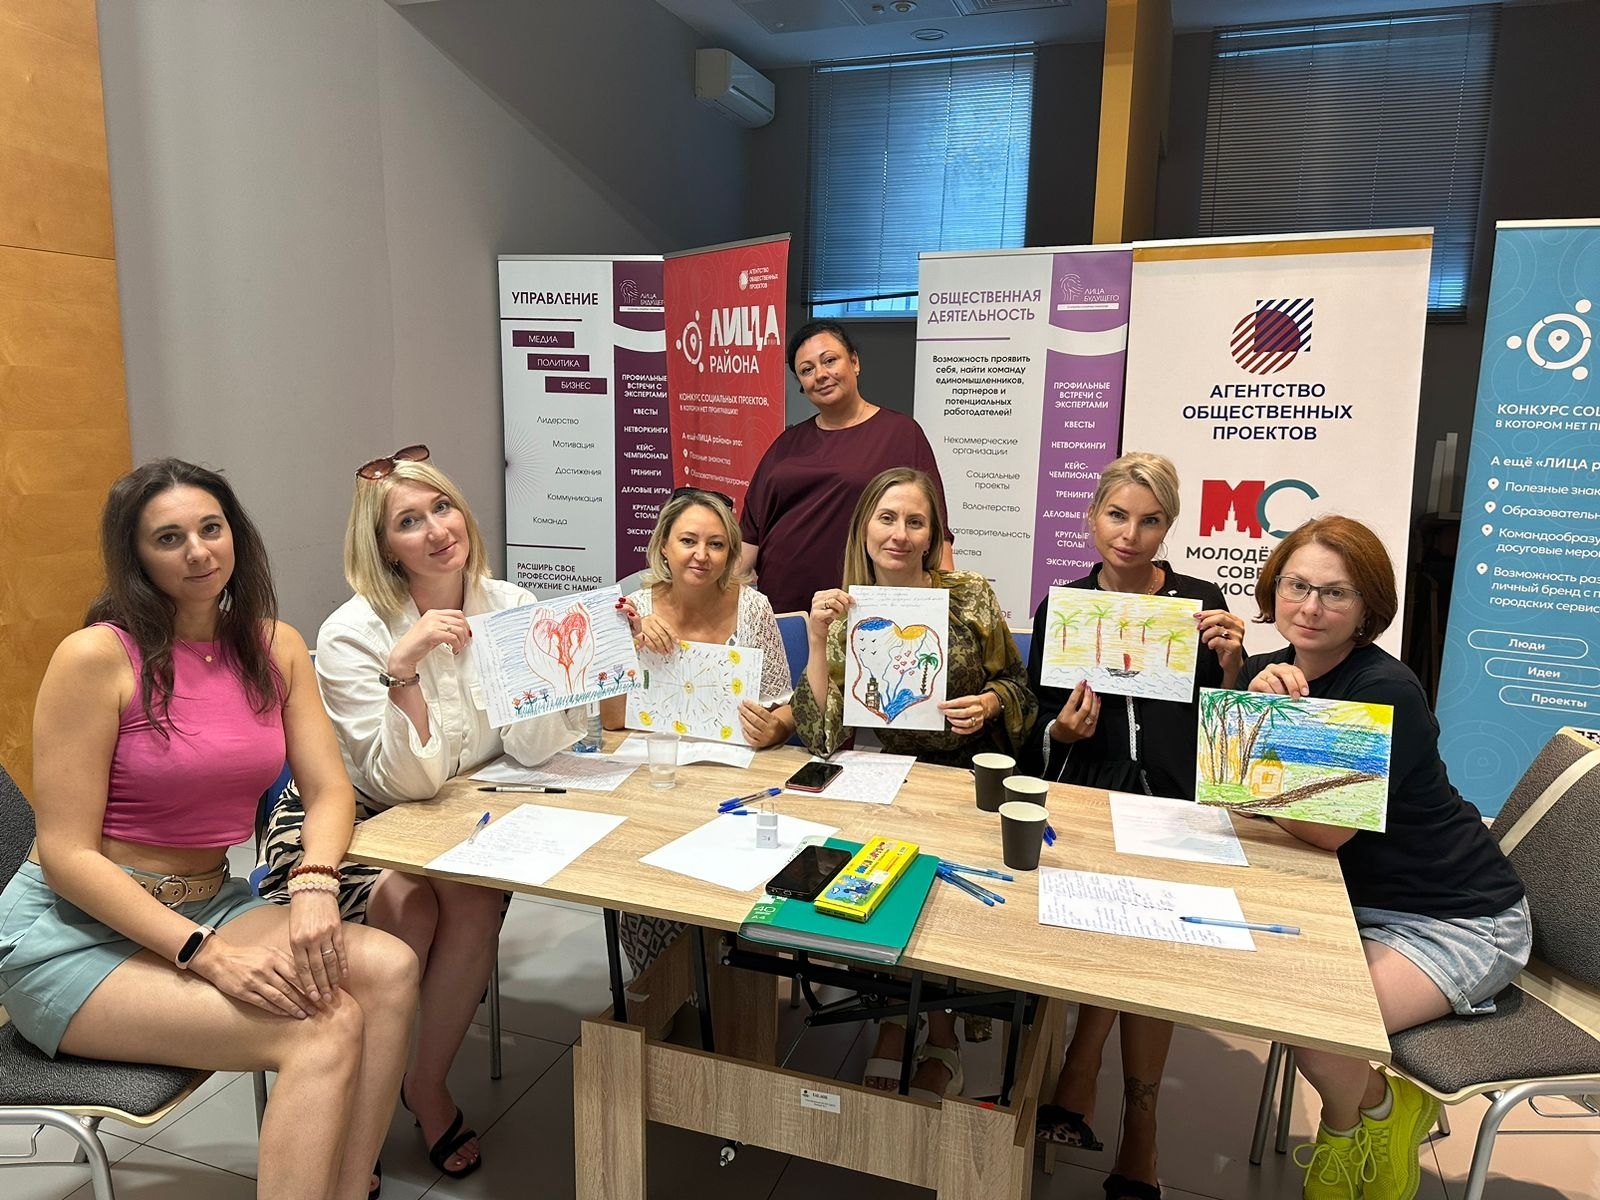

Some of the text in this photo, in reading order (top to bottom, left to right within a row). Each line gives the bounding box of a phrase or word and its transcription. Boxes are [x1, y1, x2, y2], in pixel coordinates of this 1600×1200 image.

[512, 292, 598, 305] УПРАВЛЕНИЕ
[928, 289, 1041, 306] ОБЩЕСТВЕННАЯ
[928, 308, 1034, 324] ДЕЯТЕЛЬНОСТЬ
[710, 304, 780, 352] ЛИЦА
[528, 335, 558, 344] МЕДИА
[537, 358, 580, 368] ПОЛИТИКА
[710, 348, 760, 374] РАЙОНА
[936, 366, 958, 374] себя,
[561, 381, 591, 390] БИЗНЕС
[952, 388, 998, 396] партнеров
[1210, 384, 1326, 398] АГЕНТСТВО
[738, 396, 770, 407] ПРОЕКТОВ,
[944, 408, 1012, 416] работодателей!
[1182, 404, 1353, 422] ОБЩЕСТВЕННЫХ
[1497, 404, 1570, 416] КОНКУРС
[536, 416, 579, 426] Лидерство
[1505, 420, 1562, 430] КОТОРОМ
[1565, 422, 1588, 430] НЕТ
[1212, 426, 1318, 440] ПРОЕКТОВ
[552, 440, 594, 450] Мотивация
[944, 436, 1018, 446] Некоммерческие
[1052, 442, 1106, 450] НЕТВОРКИНГИ
[636, 443, 656, 451] КЕЙС-
[952, 448, 1008, 456] организации
[1064, 461, 1088, 470] КЕЙС-
[1490, 456, 1500, 466] А
[1504, 457, 1532, 468] ещё
[1536, 458, 1588, 470] «ЛИЦА
[555, 466, 602, 476] Достижения
[966, 470, 1020, 480] Социальные
[975, 482, 1010, 490] проекты
[1505, 482, 1568, 494] Полезные
[547, 493, 602, 503] Коммуникация
[1056, 490, 1094, 498] ТРЕНИНГИ
[962, 502, 1020, 512] Волонтерство
[1042, 510, 1080, 518] ДЕЛОВЫЕ
[533, 516, 568, 525] Команда
[1499, 528, 1600, 546] Командообразу
[1056, 540, 1086, 548] СТОЛЫ
[1496, 542, 1562, 557] досуговые
[517, 562, 576, 572] РАСШИРЬ СВОЕ
[1046, 558, 1094, 568] ЭКСКУРСИИ
[518, 572, 602, 583] ПРОФЕССИОНАЛЬНОЕ
[1494, 566, 1577, 582] Возможность
[518, 582, 562, 590] ОКРУЖЕНИЕ
[1492, 582, 1538, 593] личный
[1542, 584, 1581, 598] бренд
[1490, 596, 1600, 614] городских сервис
[1508, 638, 1545, 650] Люди
[1528, 666, 1560, 678] Идеи
[1531, 693, 1587, 708] Проекты
